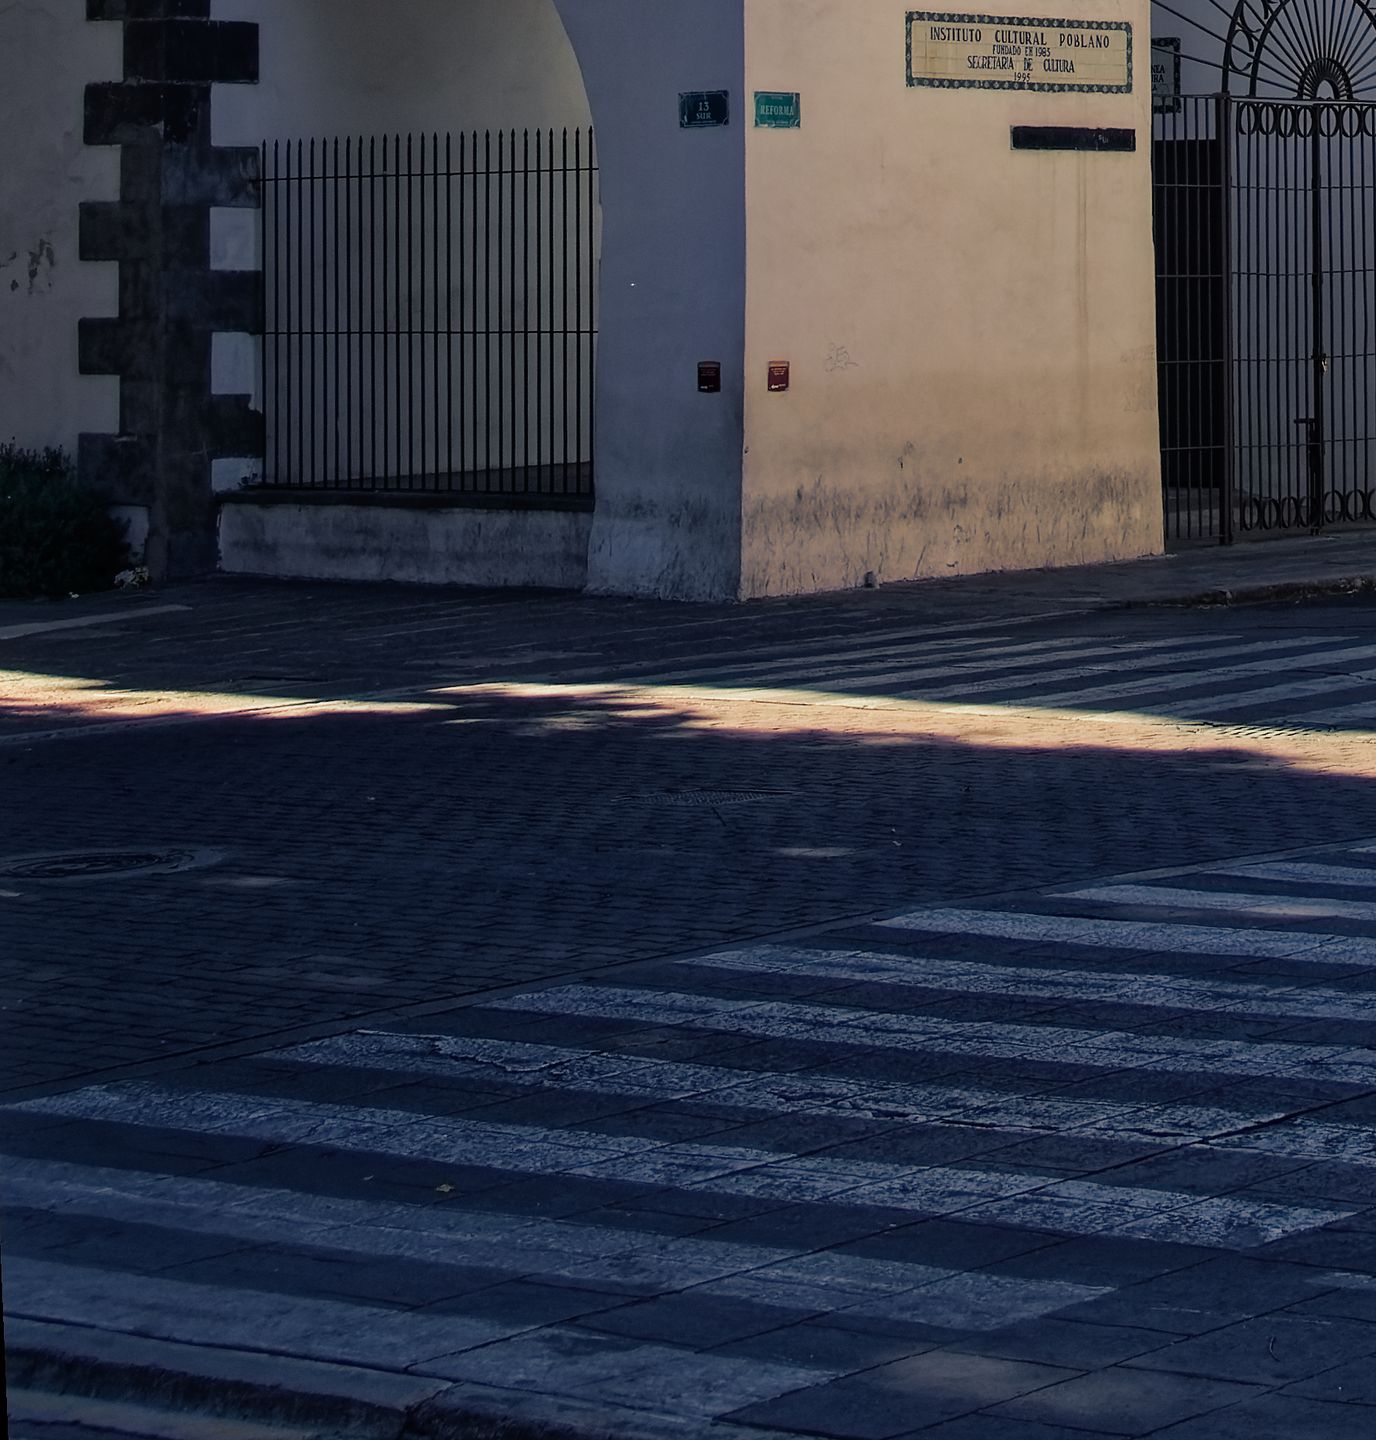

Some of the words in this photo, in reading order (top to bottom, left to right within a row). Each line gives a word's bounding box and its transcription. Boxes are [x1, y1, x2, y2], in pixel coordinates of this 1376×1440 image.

[930, 26, 982, 42] INSTITUTO
[995, 29, 1047, 46] CULTURAL
[1059, 32, 1110, 48] POBLANO
[992, 44, 1022, 56] FUNDADO
[1023, 57, 1033, 72] DE
[1043, 58, 1075, 73] CULTURA
[1014, 72, 1030, 82] 1995
[698, 101, 710, 112] 13
[760, 104, 794, 116] REFORMA
[696, 112, 712, 120] SUR
